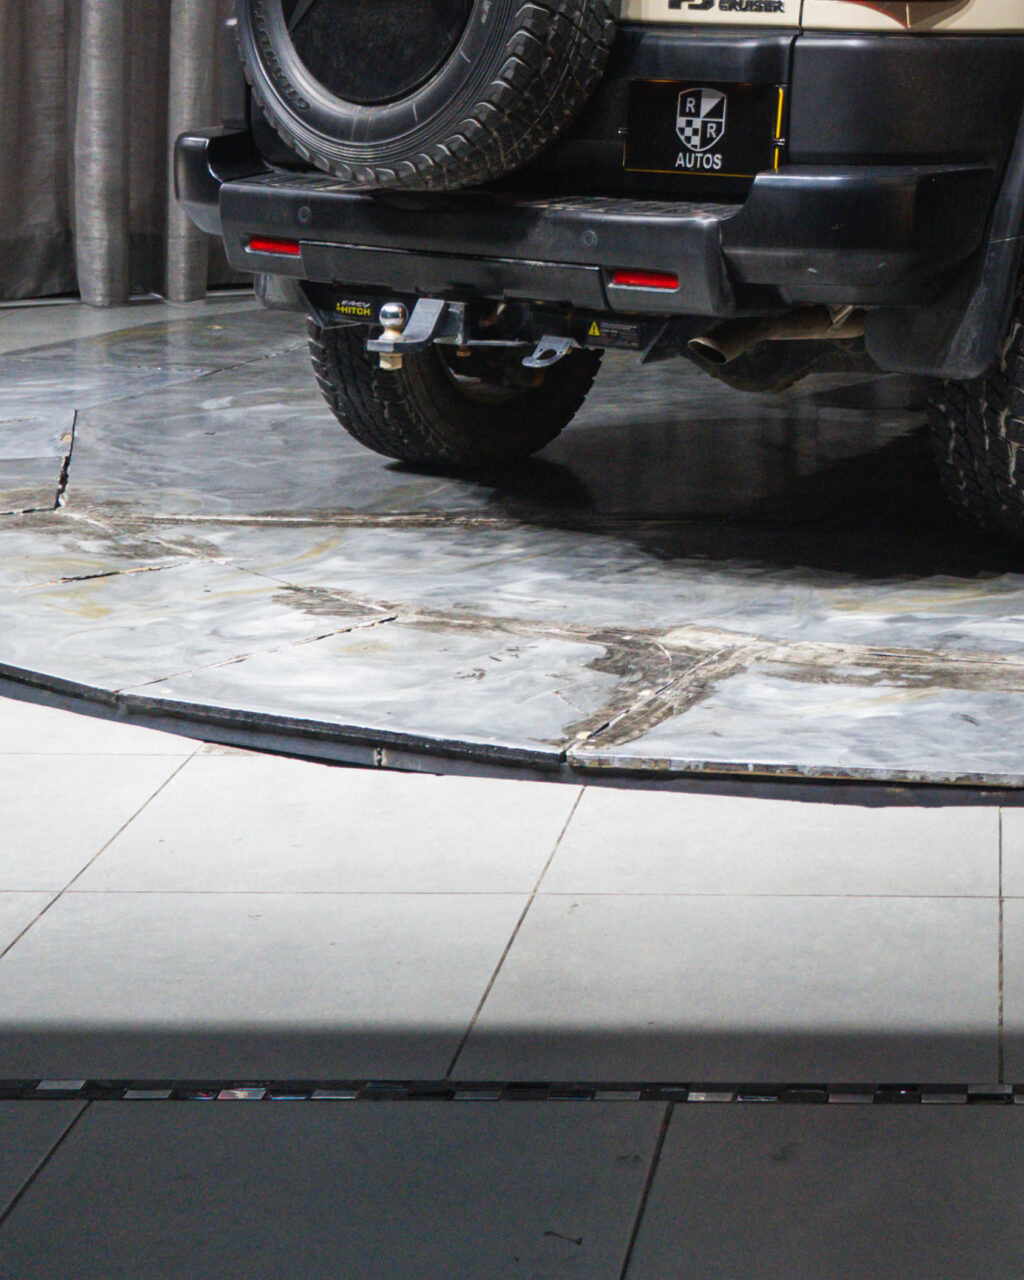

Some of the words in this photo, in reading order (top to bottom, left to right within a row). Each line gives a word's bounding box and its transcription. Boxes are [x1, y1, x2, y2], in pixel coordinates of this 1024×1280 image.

[685, 97, 696, 113] R
[706, 122, 717, 139] R
[675, 152, 723, 170] AUTOS
[341, 305, 371, 316] HITCH
